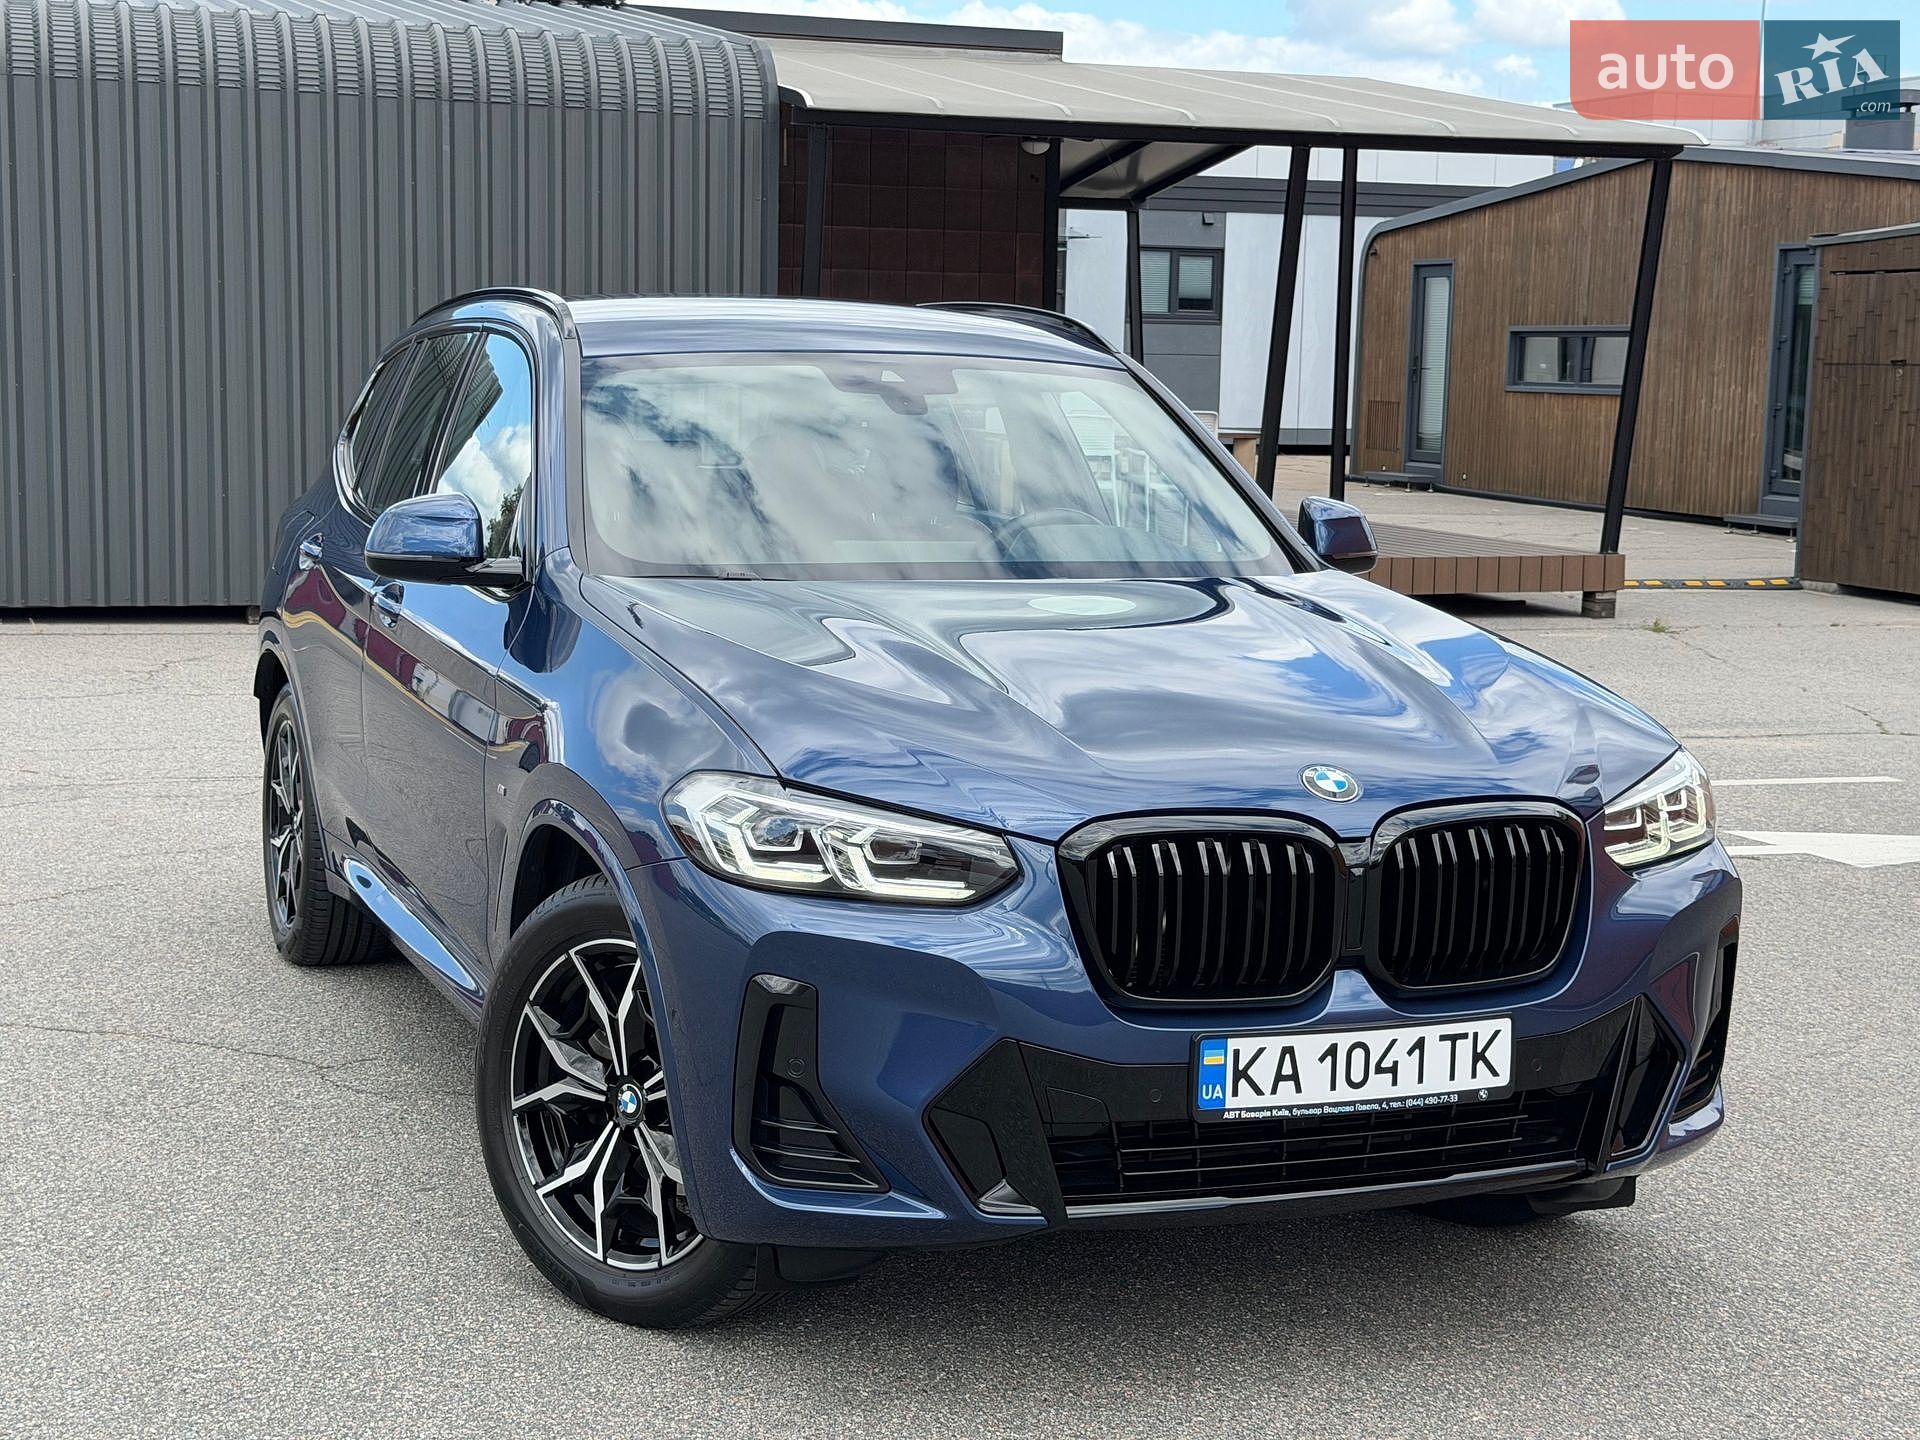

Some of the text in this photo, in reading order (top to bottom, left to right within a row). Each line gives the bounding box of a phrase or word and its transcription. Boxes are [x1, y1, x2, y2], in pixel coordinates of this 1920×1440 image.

[1231, 1029, 1502, 1098] KA 1041 TK
[1202, 1084, 1224, 1100] UA
[1406, 1097, 1424, 1108] (044)
